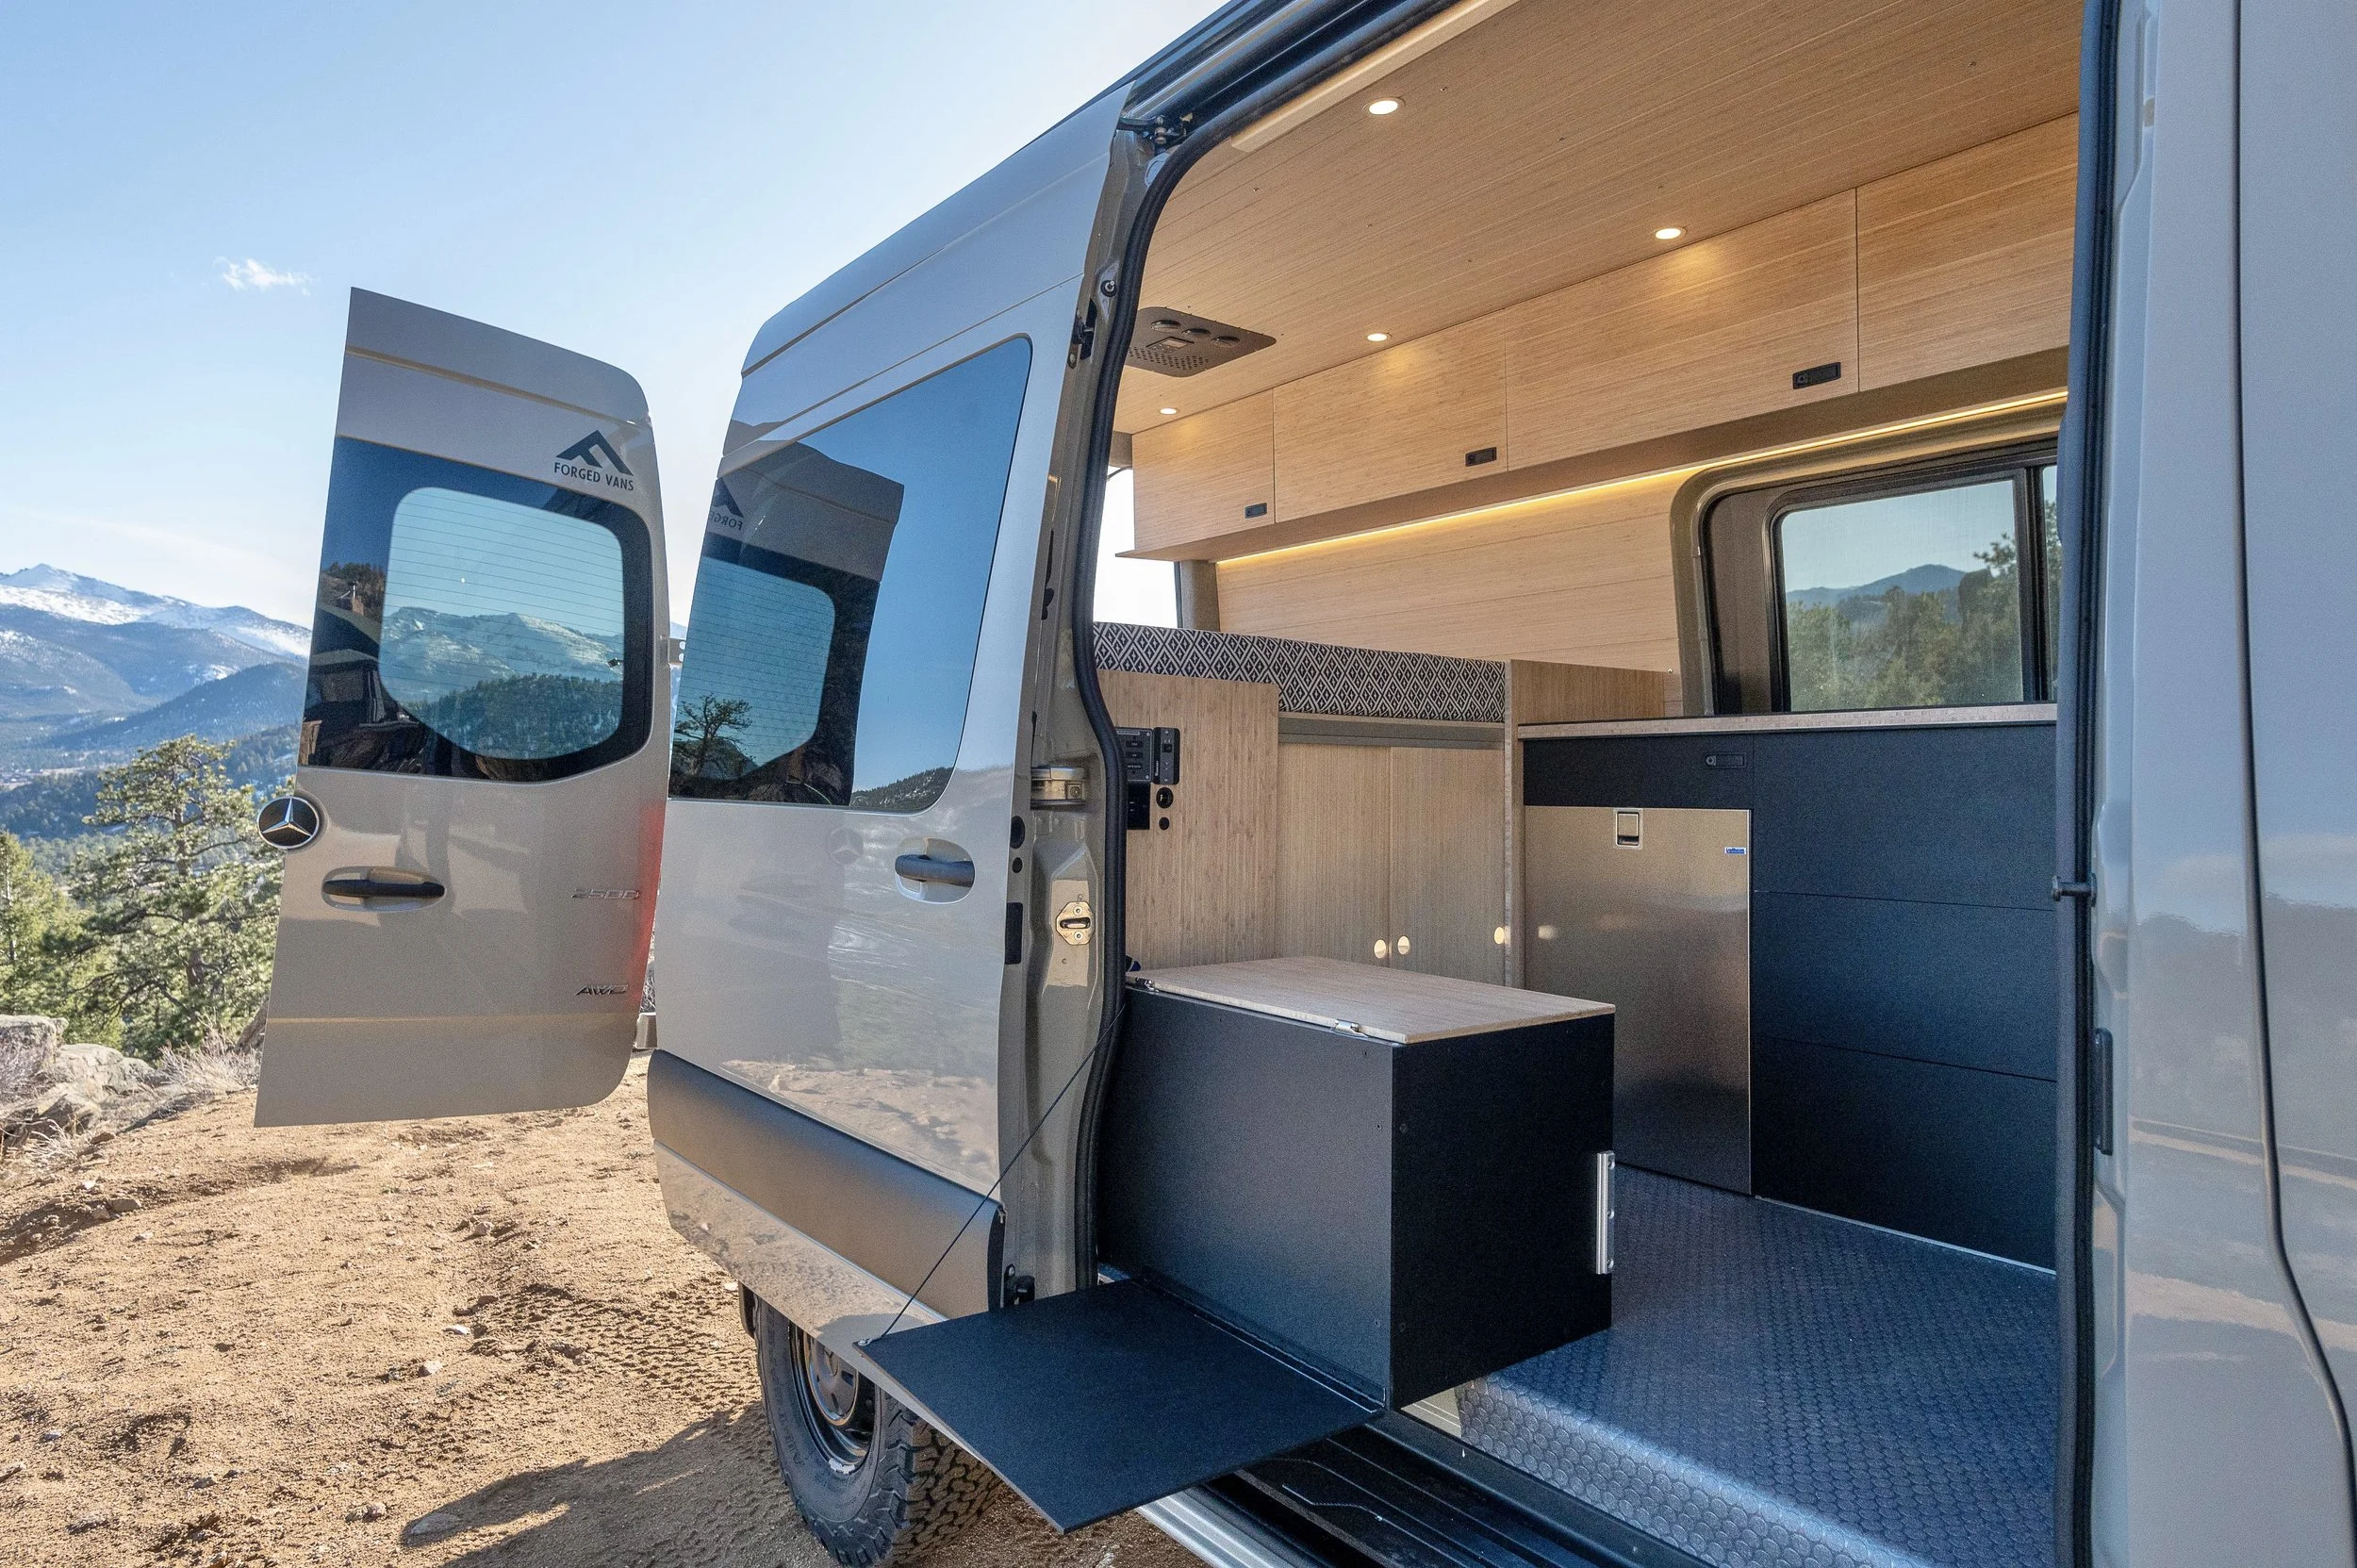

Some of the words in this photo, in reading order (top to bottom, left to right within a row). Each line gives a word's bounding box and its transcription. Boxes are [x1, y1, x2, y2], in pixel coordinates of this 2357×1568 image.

[553, 462, 601, 483] FORGED
[605, 474, 634, 491] VANS
[570, 888, 641, 900] 2500
[573, 984, 629, 997] AWD
